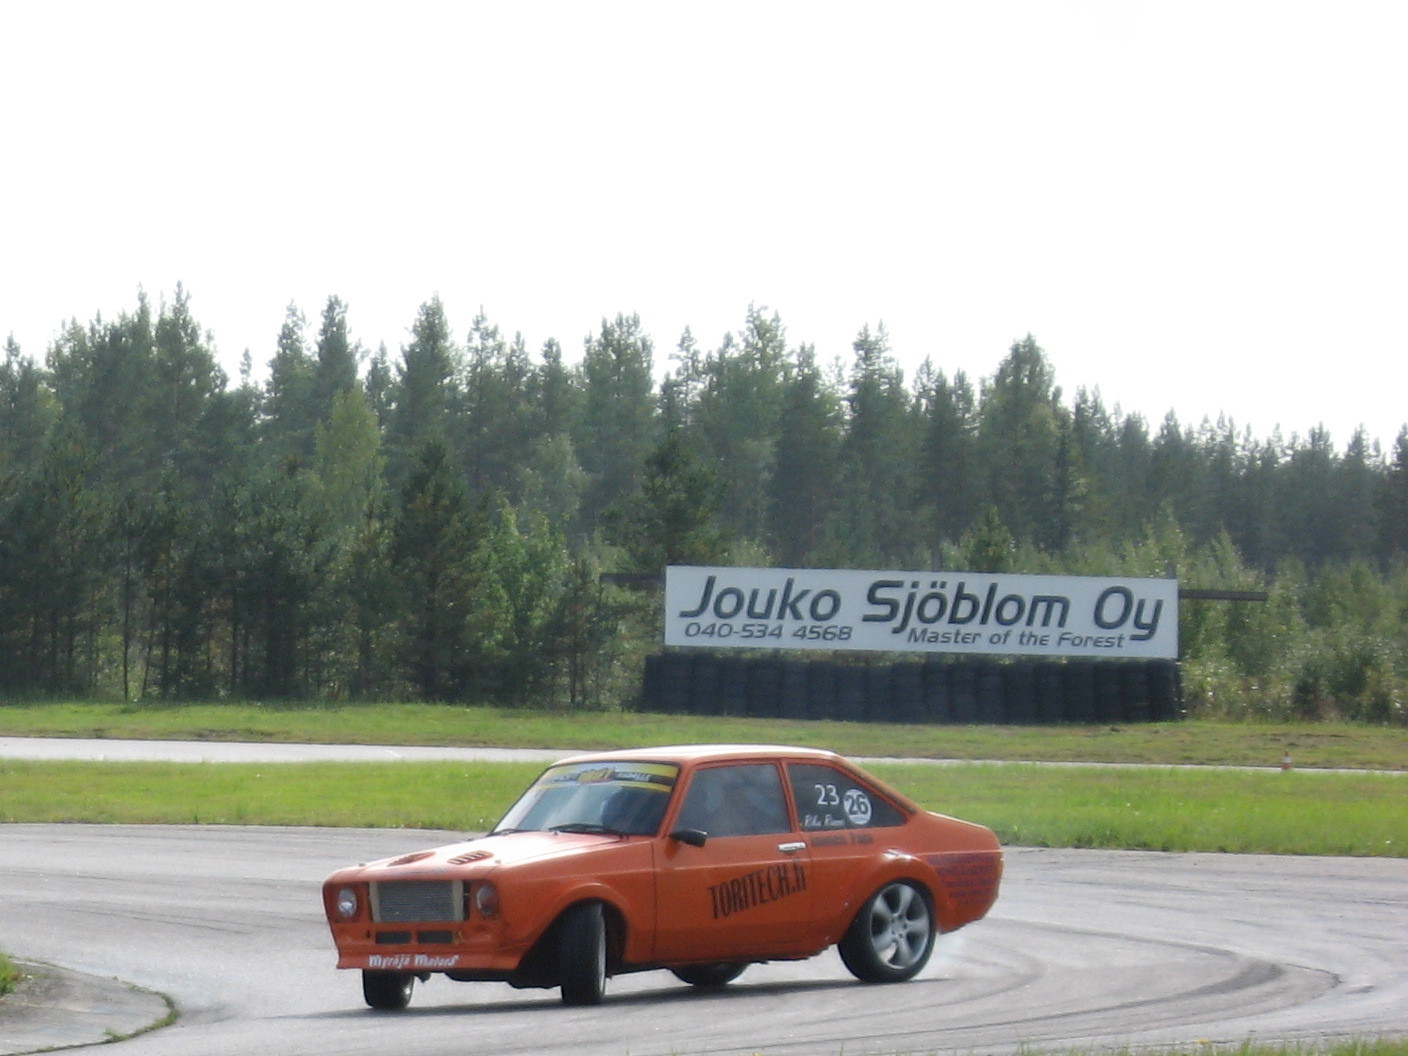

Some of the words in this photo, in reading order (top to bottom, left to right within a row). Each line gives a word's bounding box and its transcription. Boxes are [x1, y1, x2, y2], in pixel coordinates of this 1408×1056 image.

[679, 575, 842, 621] Jouko
[862, 580, 1070, 634] Sjöblom
[1094, 585, 1164, 642] Oy
[684, 622, 783, 639] 040-534
[792, 625, 853, 641] 4568
[907, 627, 981, 644] Master
[989, 630, 1012, 646] of
[1019, 631, 1051, 647] the
[1057, 631, 1125, 649] Forest
[814, 783, 840, 806] 23
[845, 794, 870, 815] 26
